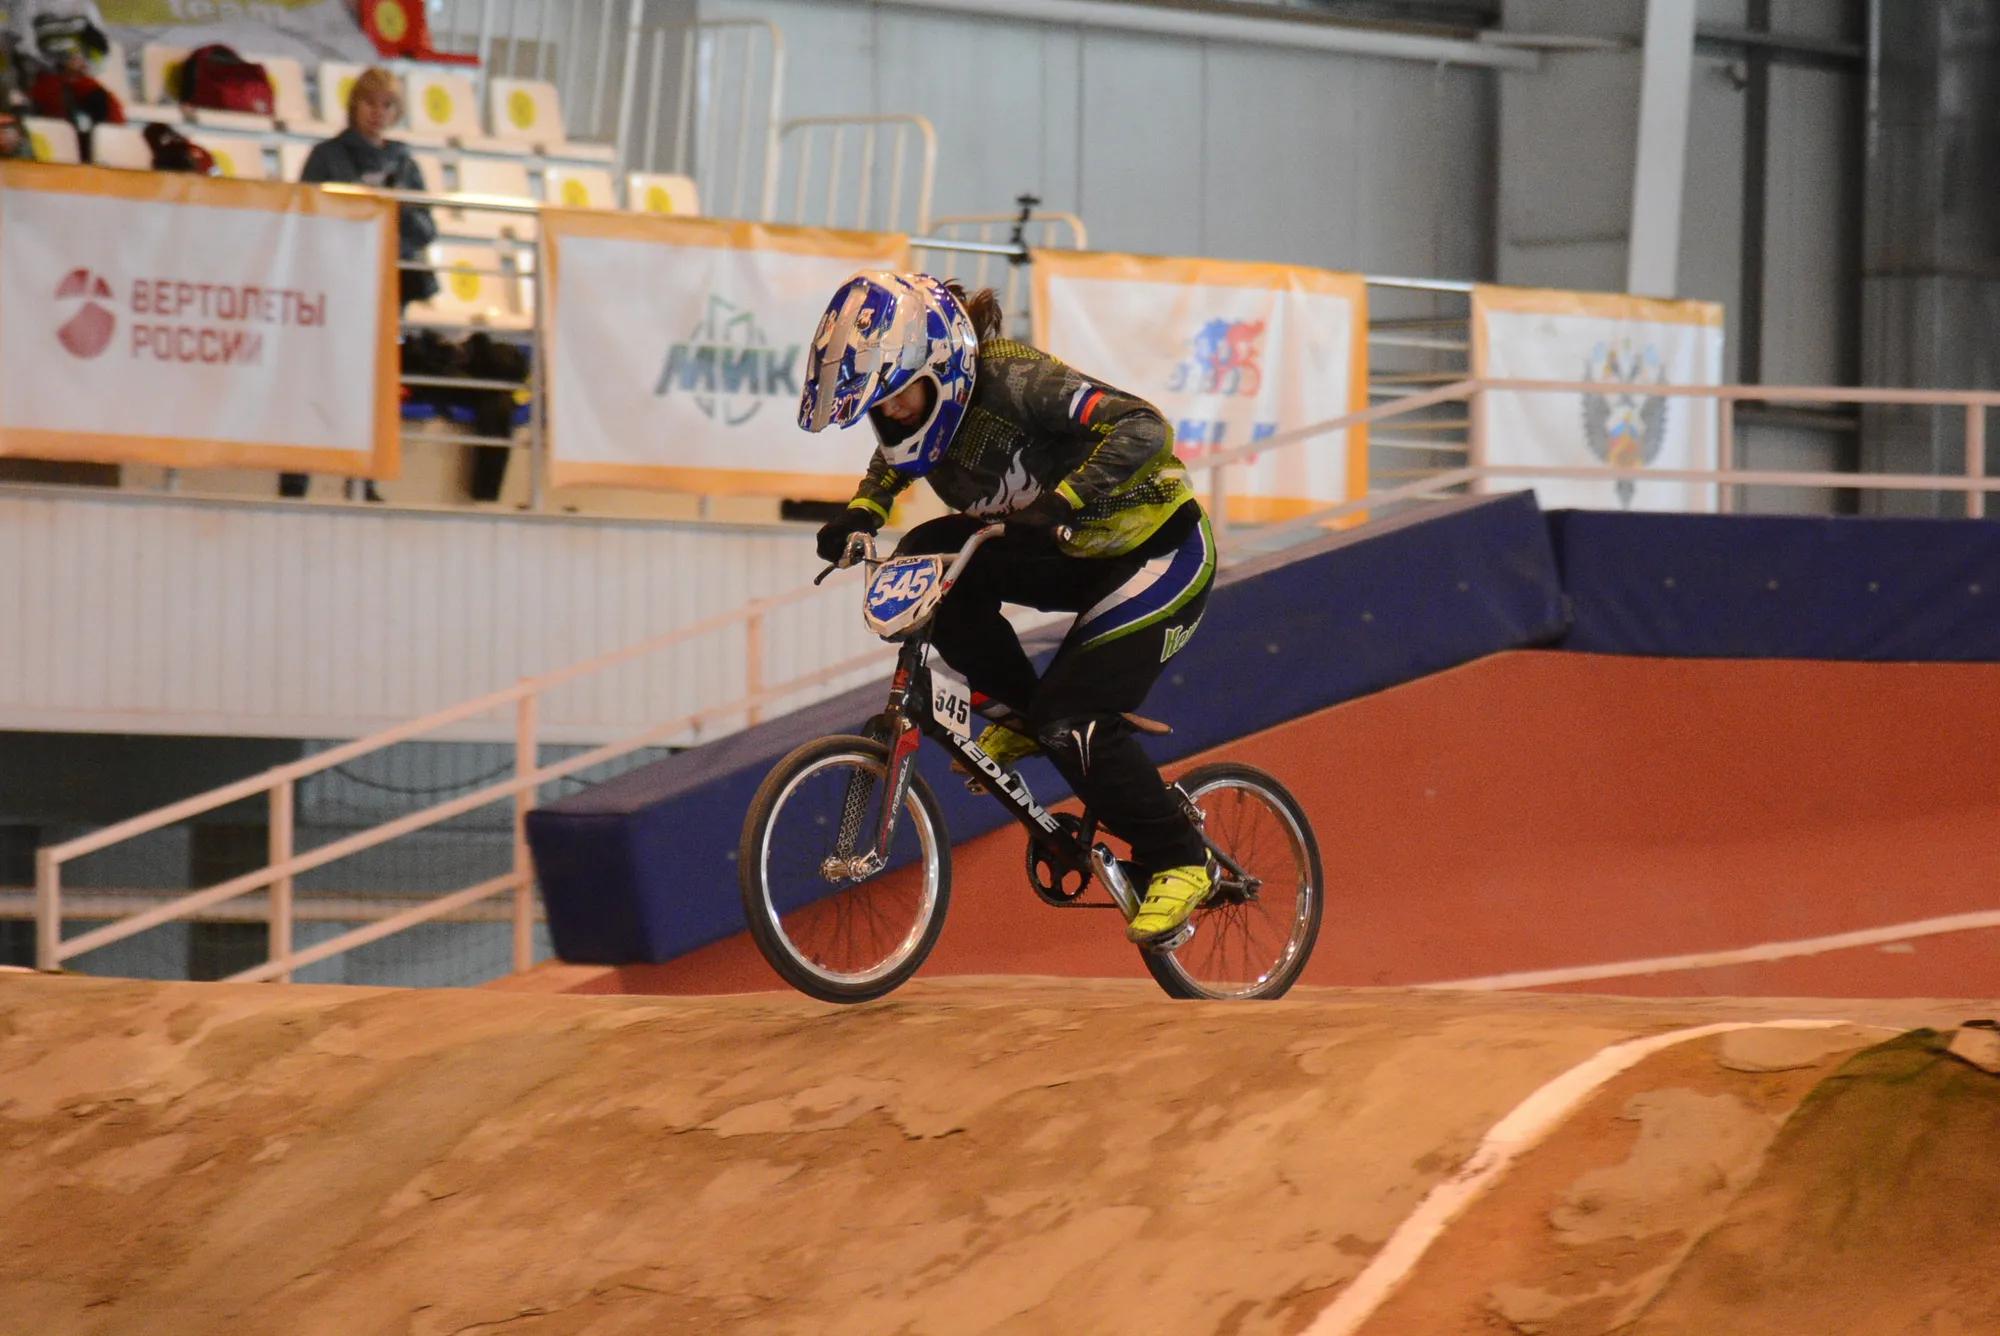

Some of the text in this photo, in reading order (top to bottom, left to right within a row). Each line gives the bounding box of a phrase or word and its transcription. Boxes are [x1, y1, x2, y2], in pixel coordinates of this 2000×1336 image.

[131, 280, 326, 327] ВЕРТОЛЕТЫ
[131, 323, 263, 364] РОССИИ
[870, 567, 934, 607] 545
[934, 687, 969, 725] 545
